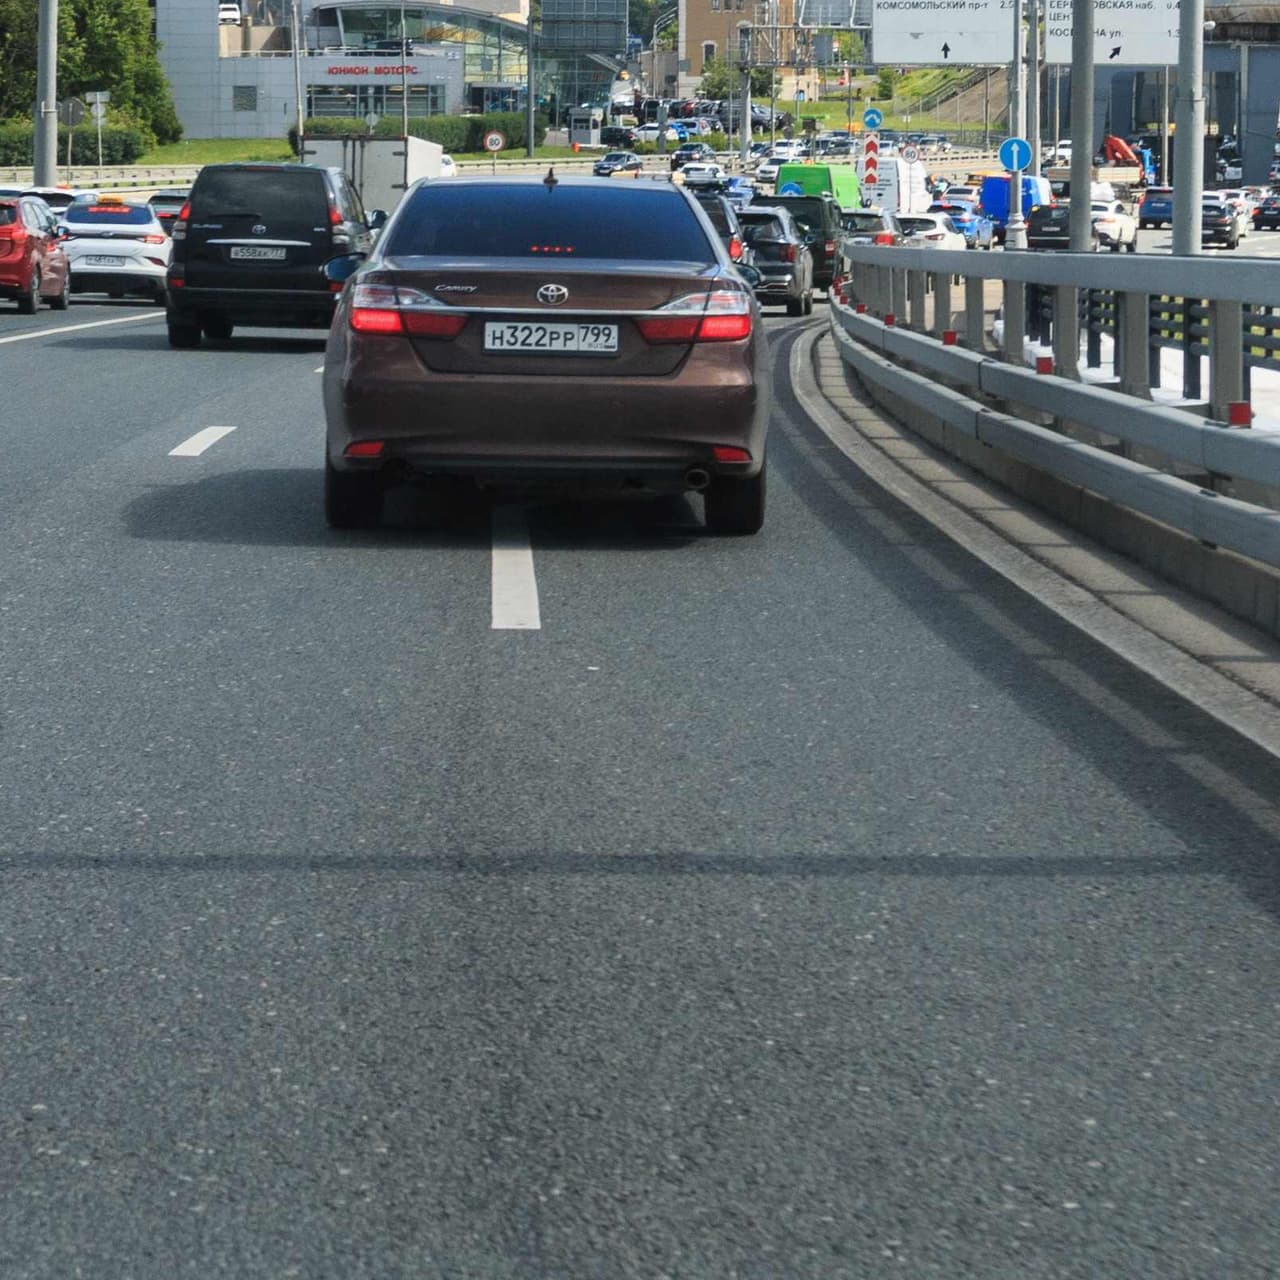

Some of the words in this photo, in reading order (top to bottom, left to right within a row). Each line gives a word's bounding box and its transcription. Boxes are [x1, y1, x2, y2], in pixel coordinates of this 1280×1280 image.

[876, 0, 966, 10] КОМСОМОЛЬСКИЙ
[1049, 0, 1133, 9] БЕРОВСКАЯ
[327, 66, 369, 76] ЮНИОН
[373, 66, 419, 76] МОТОРС
[580, 326, 612, 343] 799
